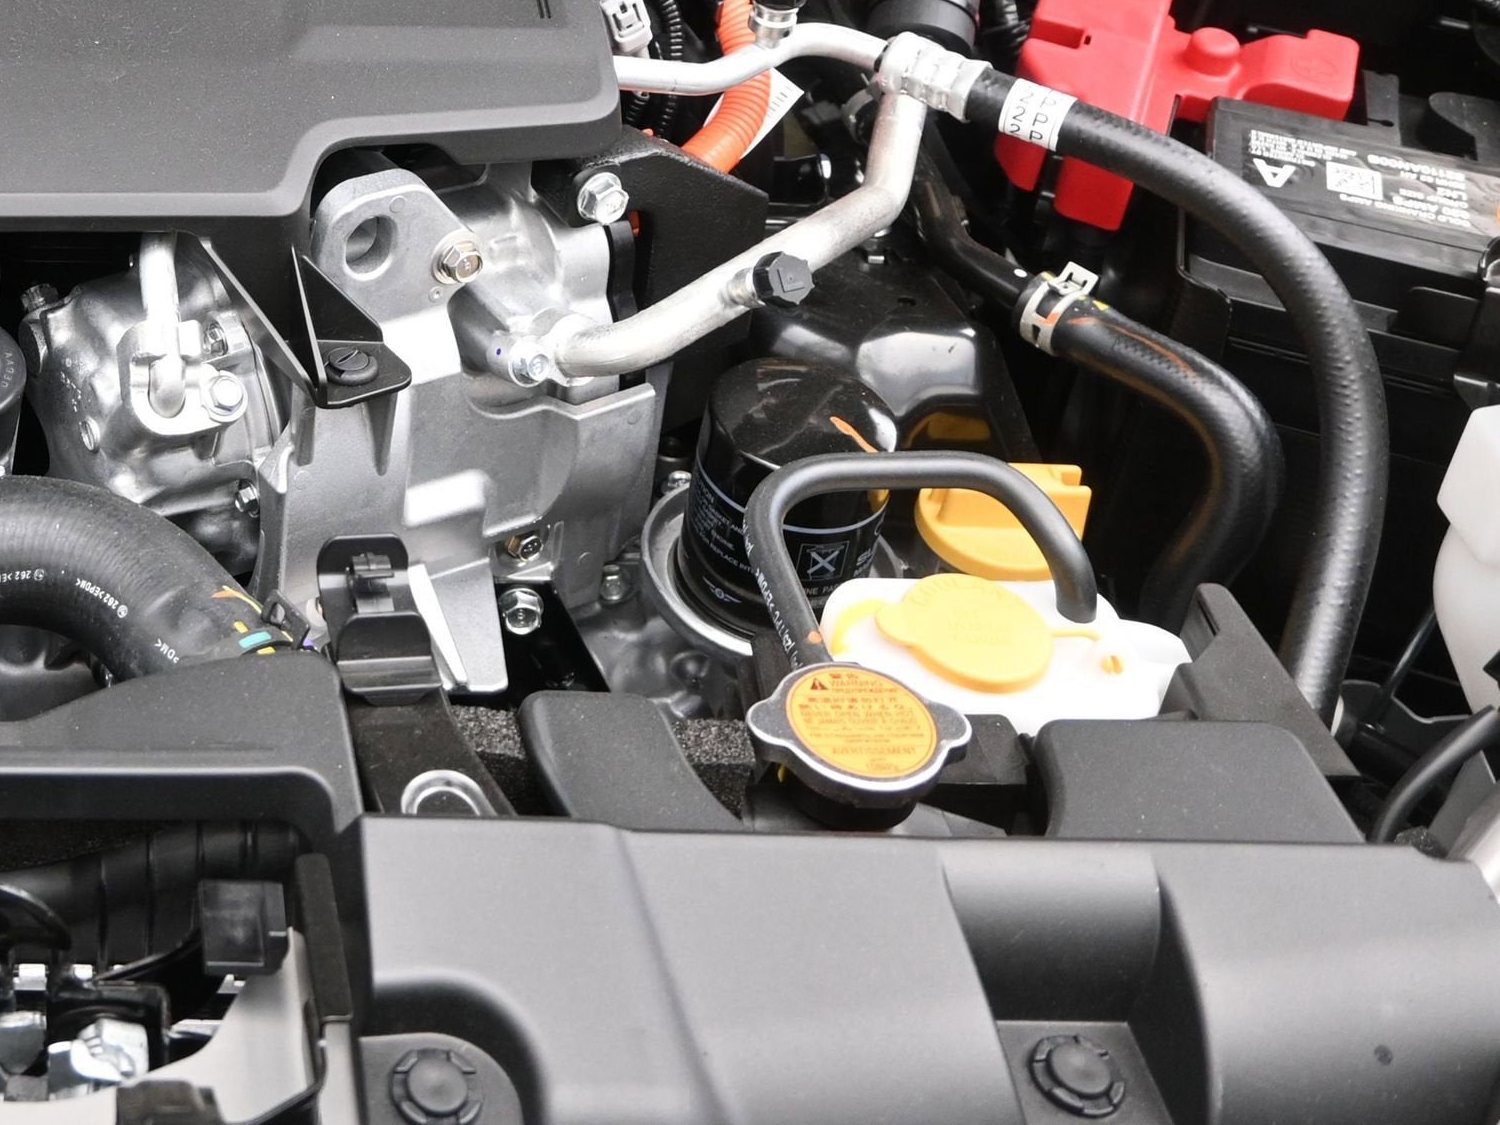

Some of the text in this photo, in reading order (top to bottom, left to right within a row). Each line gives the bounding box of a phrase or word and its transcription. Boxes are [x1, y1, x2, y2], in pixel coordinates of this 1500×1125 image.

[1252, 157, 1297, 188] A
[1339, 193, 1471, 227] COLD CRANKING AMPS
[13, 569, 34, 582] 262
[103, 591, 121, 611] 262
